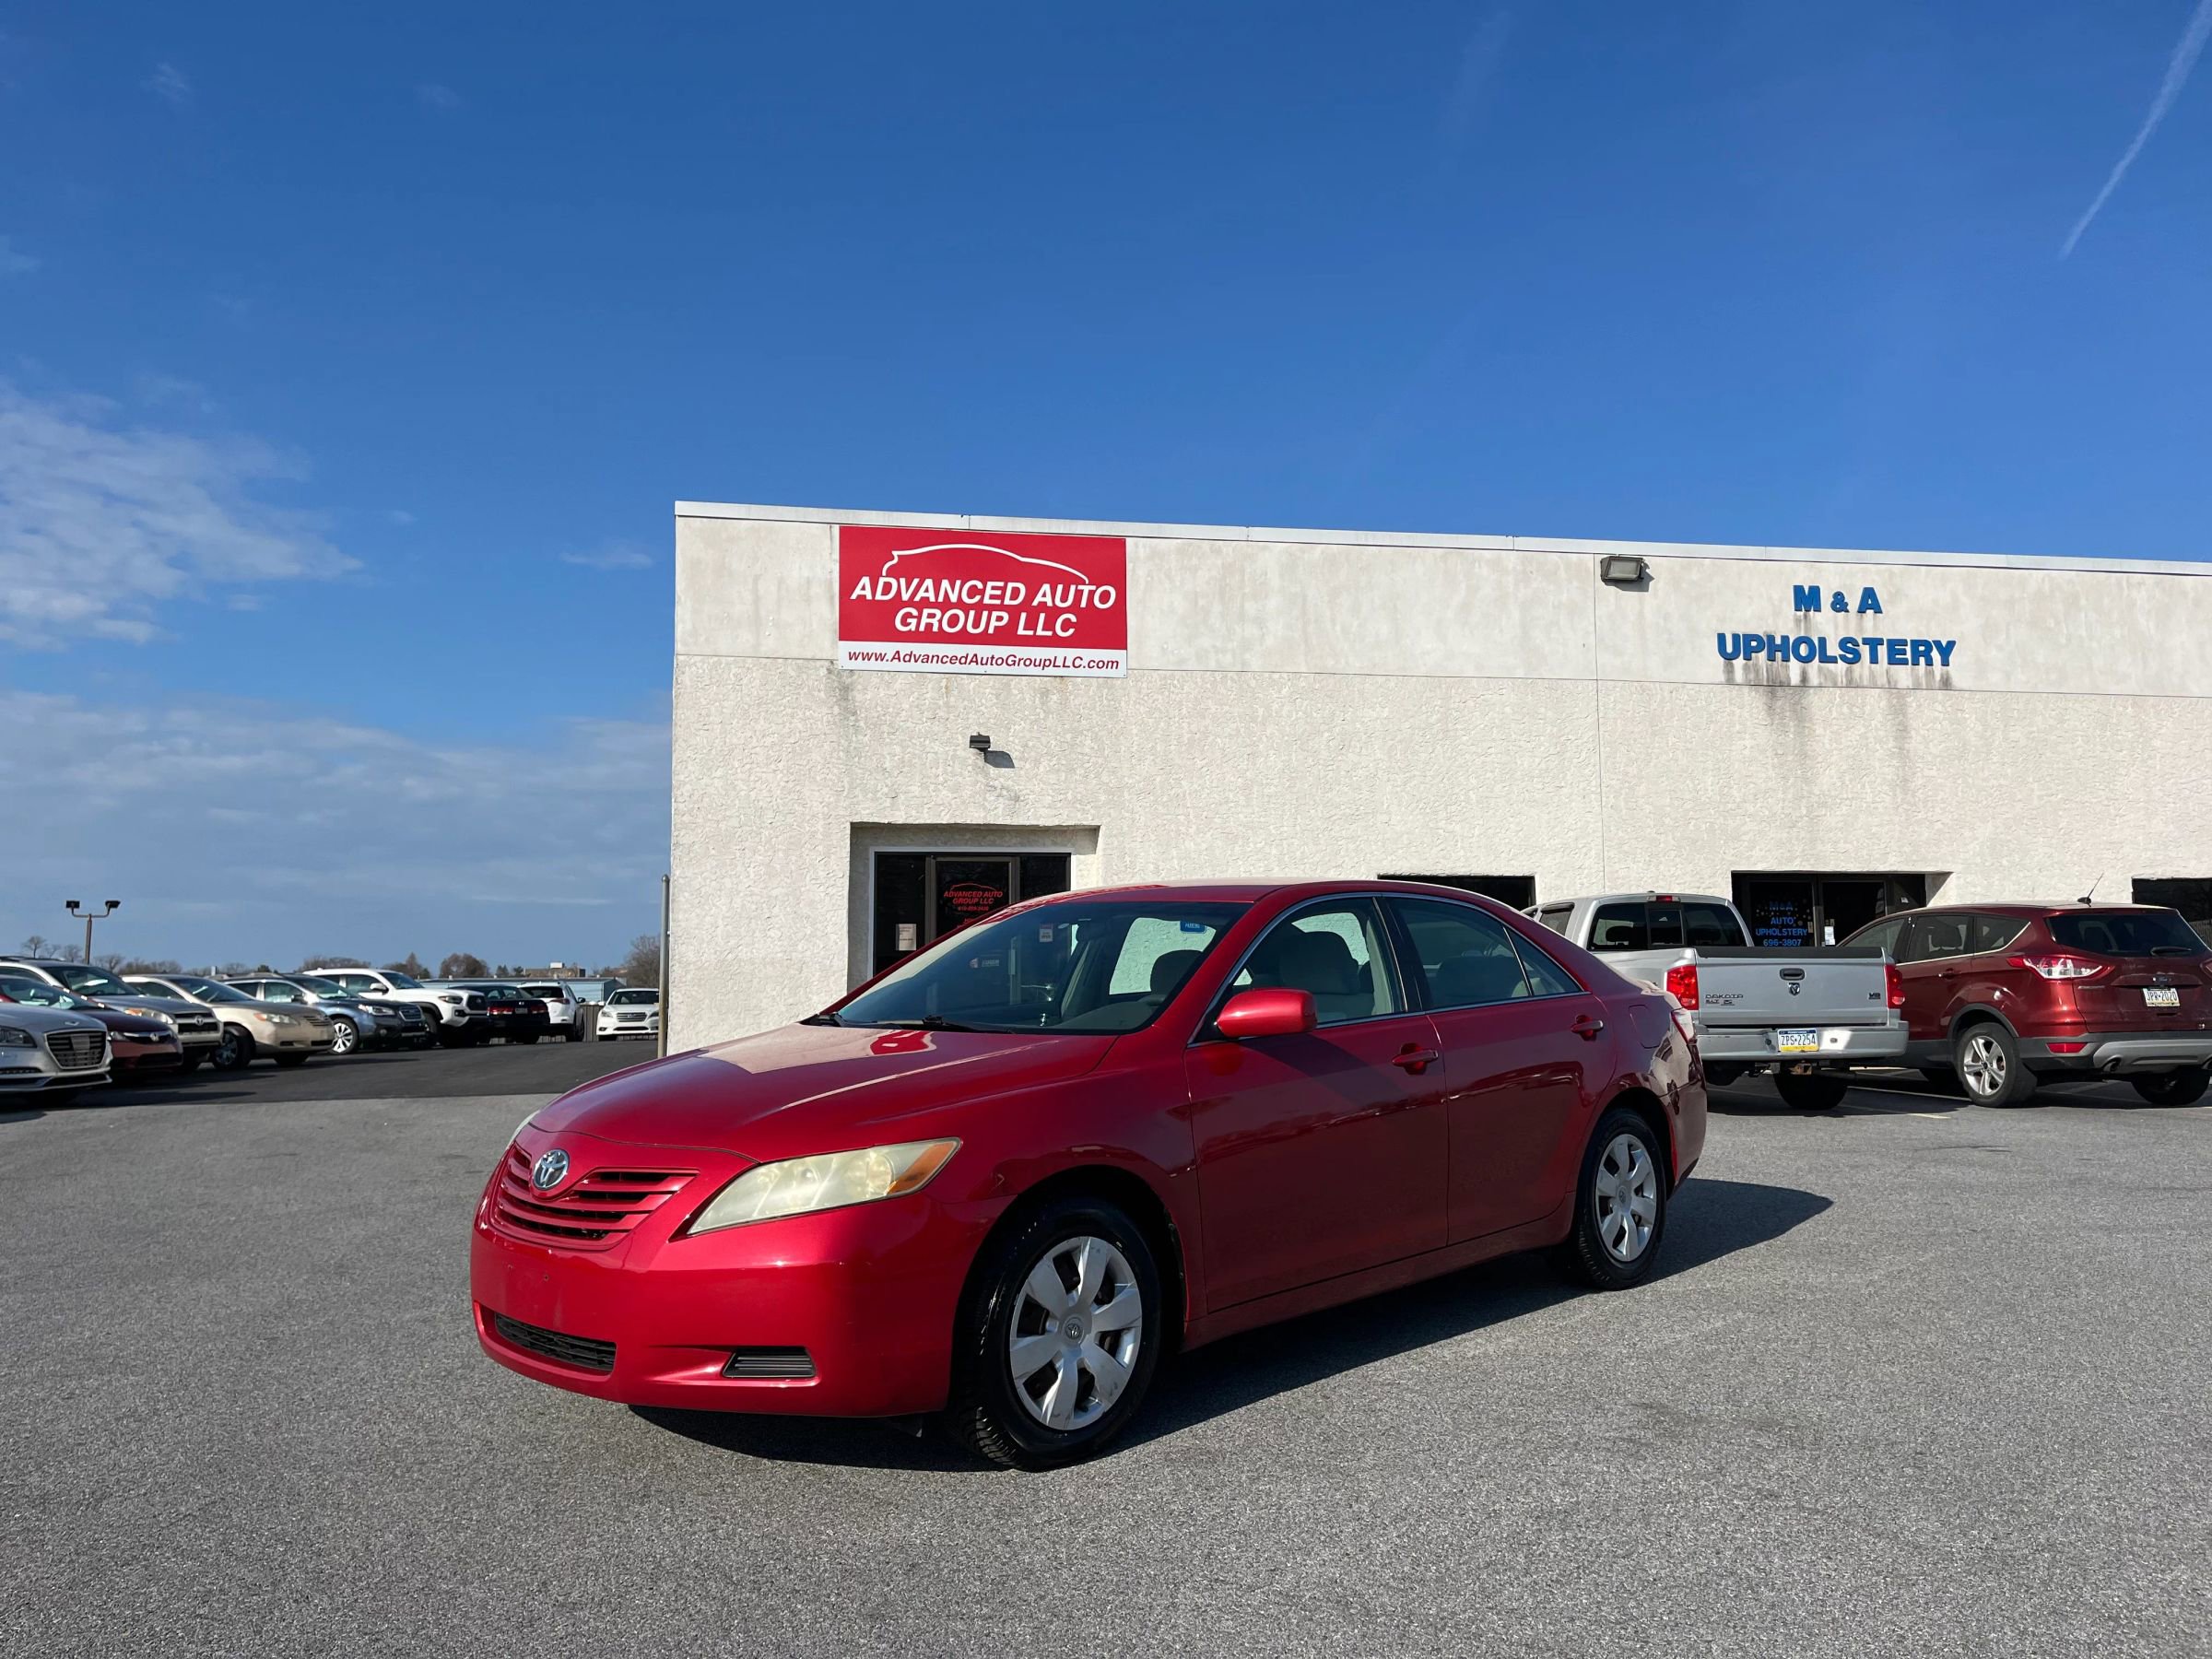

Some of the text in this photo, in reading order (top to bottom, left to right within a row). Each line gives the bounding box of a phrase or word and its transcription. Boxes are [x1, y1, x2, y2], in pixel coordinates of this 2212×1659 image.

[850, 576, 1116, 609] ADVANCED AUTO
[1793, 584, 1883, 614] M & A
[894, 607, 1077, 637] GROUP LLC
[848, 650, 1120, 671] www.AdvancedAutoGroupLLC.com
[1716, 632, 1957, 667] UPHOLSTERY
[1755, 927, 1807, 936] UPHOLSTERY
[1771, 916, 1794, 925] AUTO
[1762, 938, 1802, 947] 696-3807
